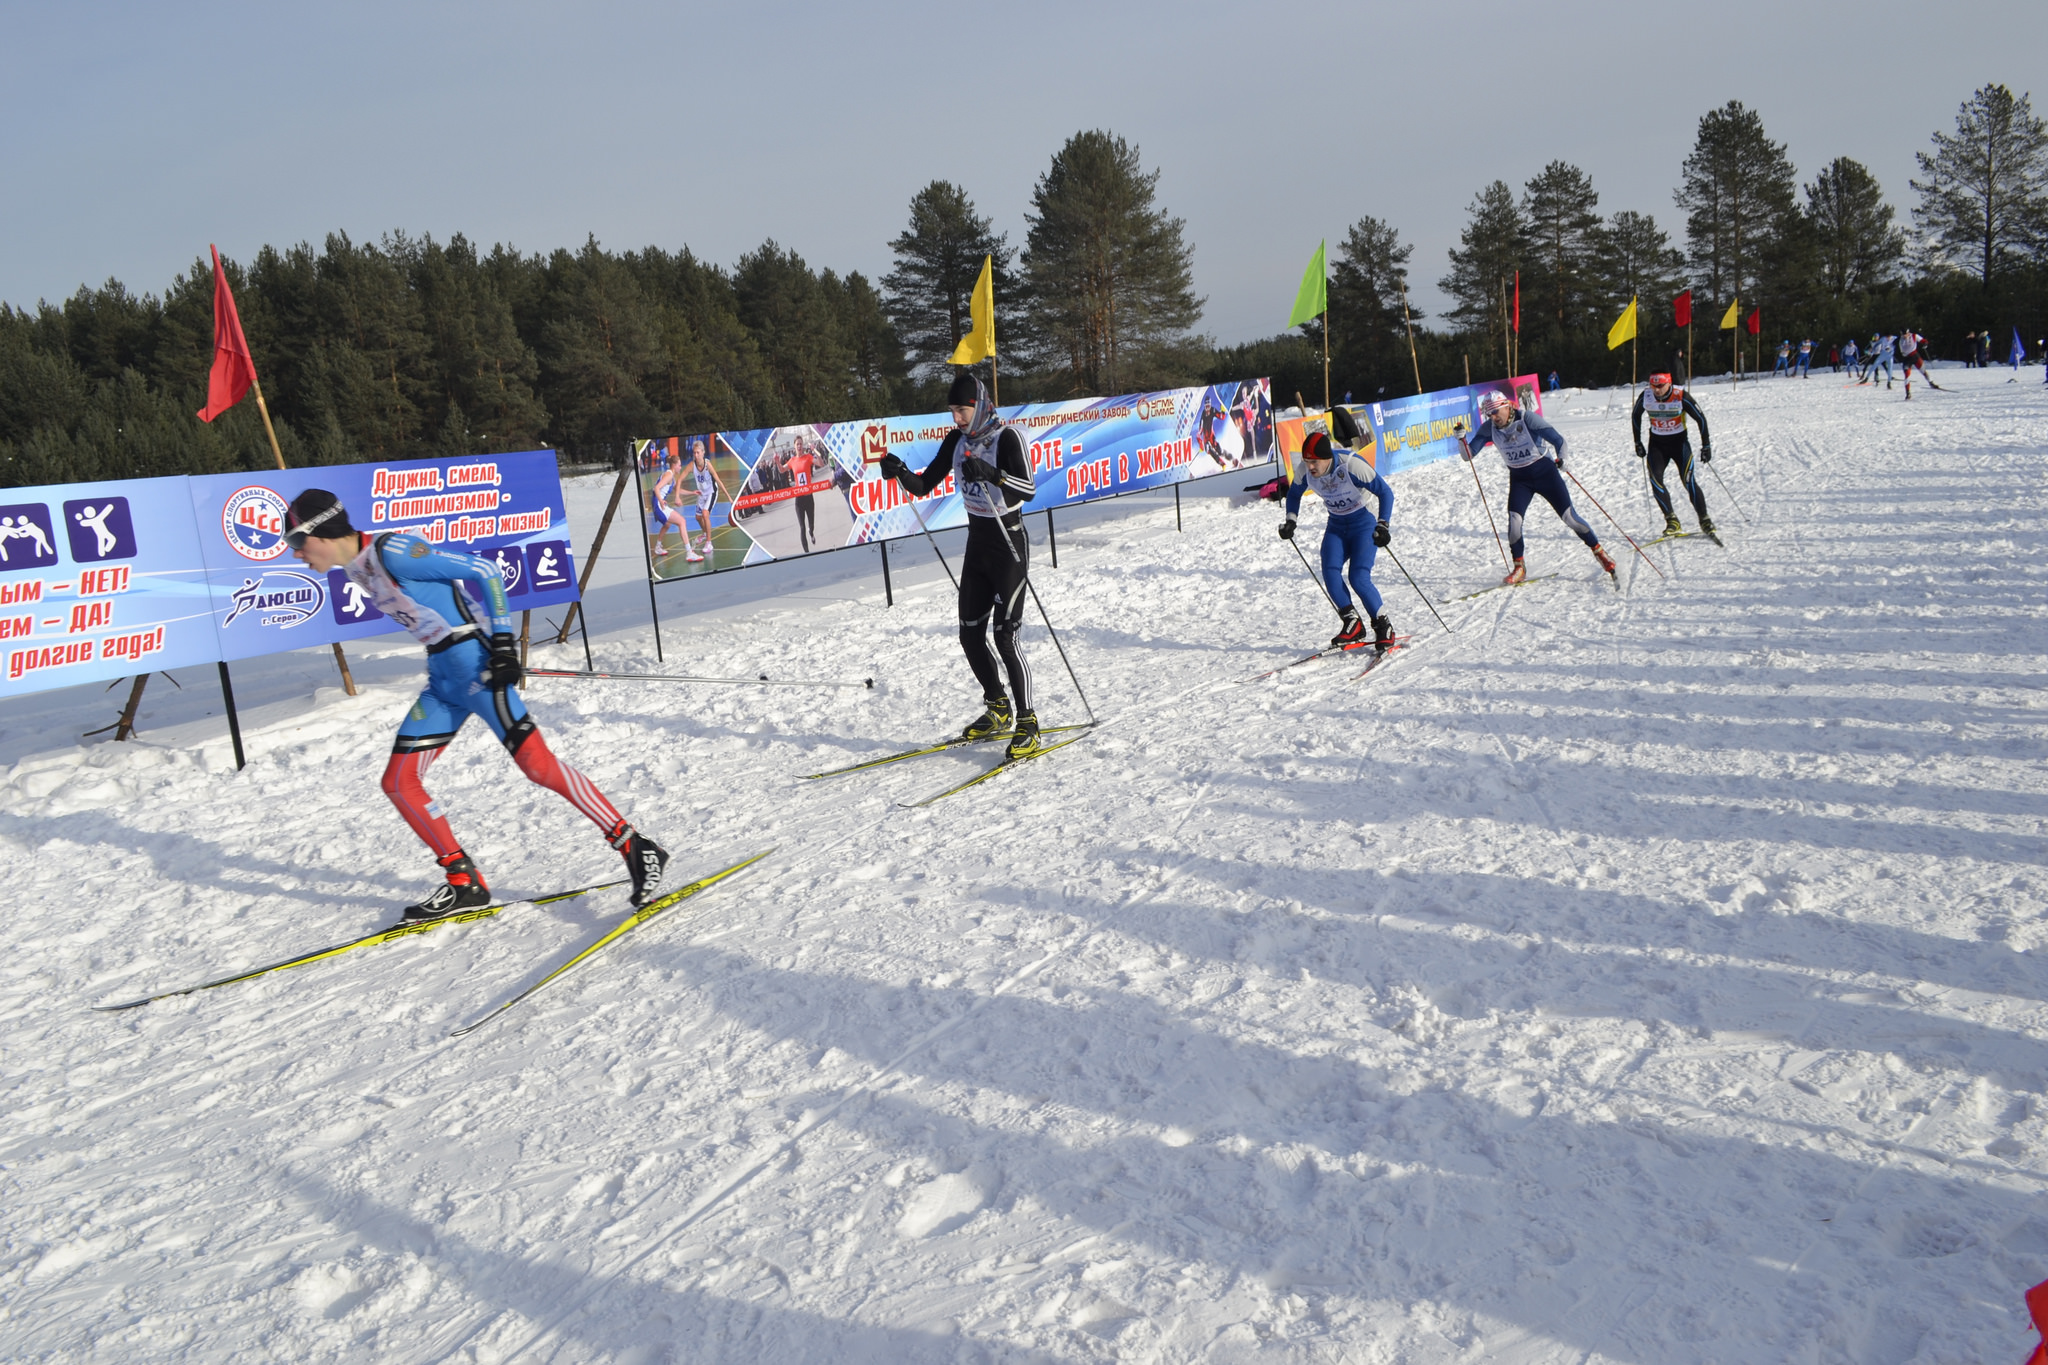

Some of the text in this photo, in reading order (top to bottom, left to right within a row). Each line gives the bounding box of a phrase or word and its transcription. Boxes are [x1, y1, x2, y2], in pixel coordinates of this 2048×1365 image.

[1151, 399, 1174, 408] УГМК
[1151, 407, 1175, 417] UMMC
[890, 431, 914, 444] ПАО
[1102, 406, 1131, 419] ЗАВОД»
[1383, 430, 1401, 453] МЫ
[1405, 423, 1431, 449] ОДНА
[1029, 438, 1062, 473] РТЕ
[1067, 437, 1192, 496] ЯРЧЕ В ЖИЗНИ
[1506, 449, 1531, 461] 3244
[374, 465, 500, 495] Дружно, смело,
[799, 474, 805, 485] 4
[851, 470, 954, 514] СИЛЕ
[962, 477, 988, 497] 32
[374, 504, 384, 521] с
[391, 492, 498, 519] оптимизмом
[773, 491, 792, 500] ГАЗЕТЫ
[226, 489, 287, 544] ЦЕНТР СПОРТИВНЫХ СООРУ
[240, 506, 281, 534] ЦСС
[451, 517, 494, 541] образ
[500, 510, 549, 534] жизни!
[246, 545, 281, 558] СЕРОВ
[80, 567, 129, 595] НЕТ!
[70, 601, 111, 633] ДА!
[272, 613, 297, 624] Серов
[10, 627, 163, 678] долгие года!
[641, 850, 661, 890] ROSSI
